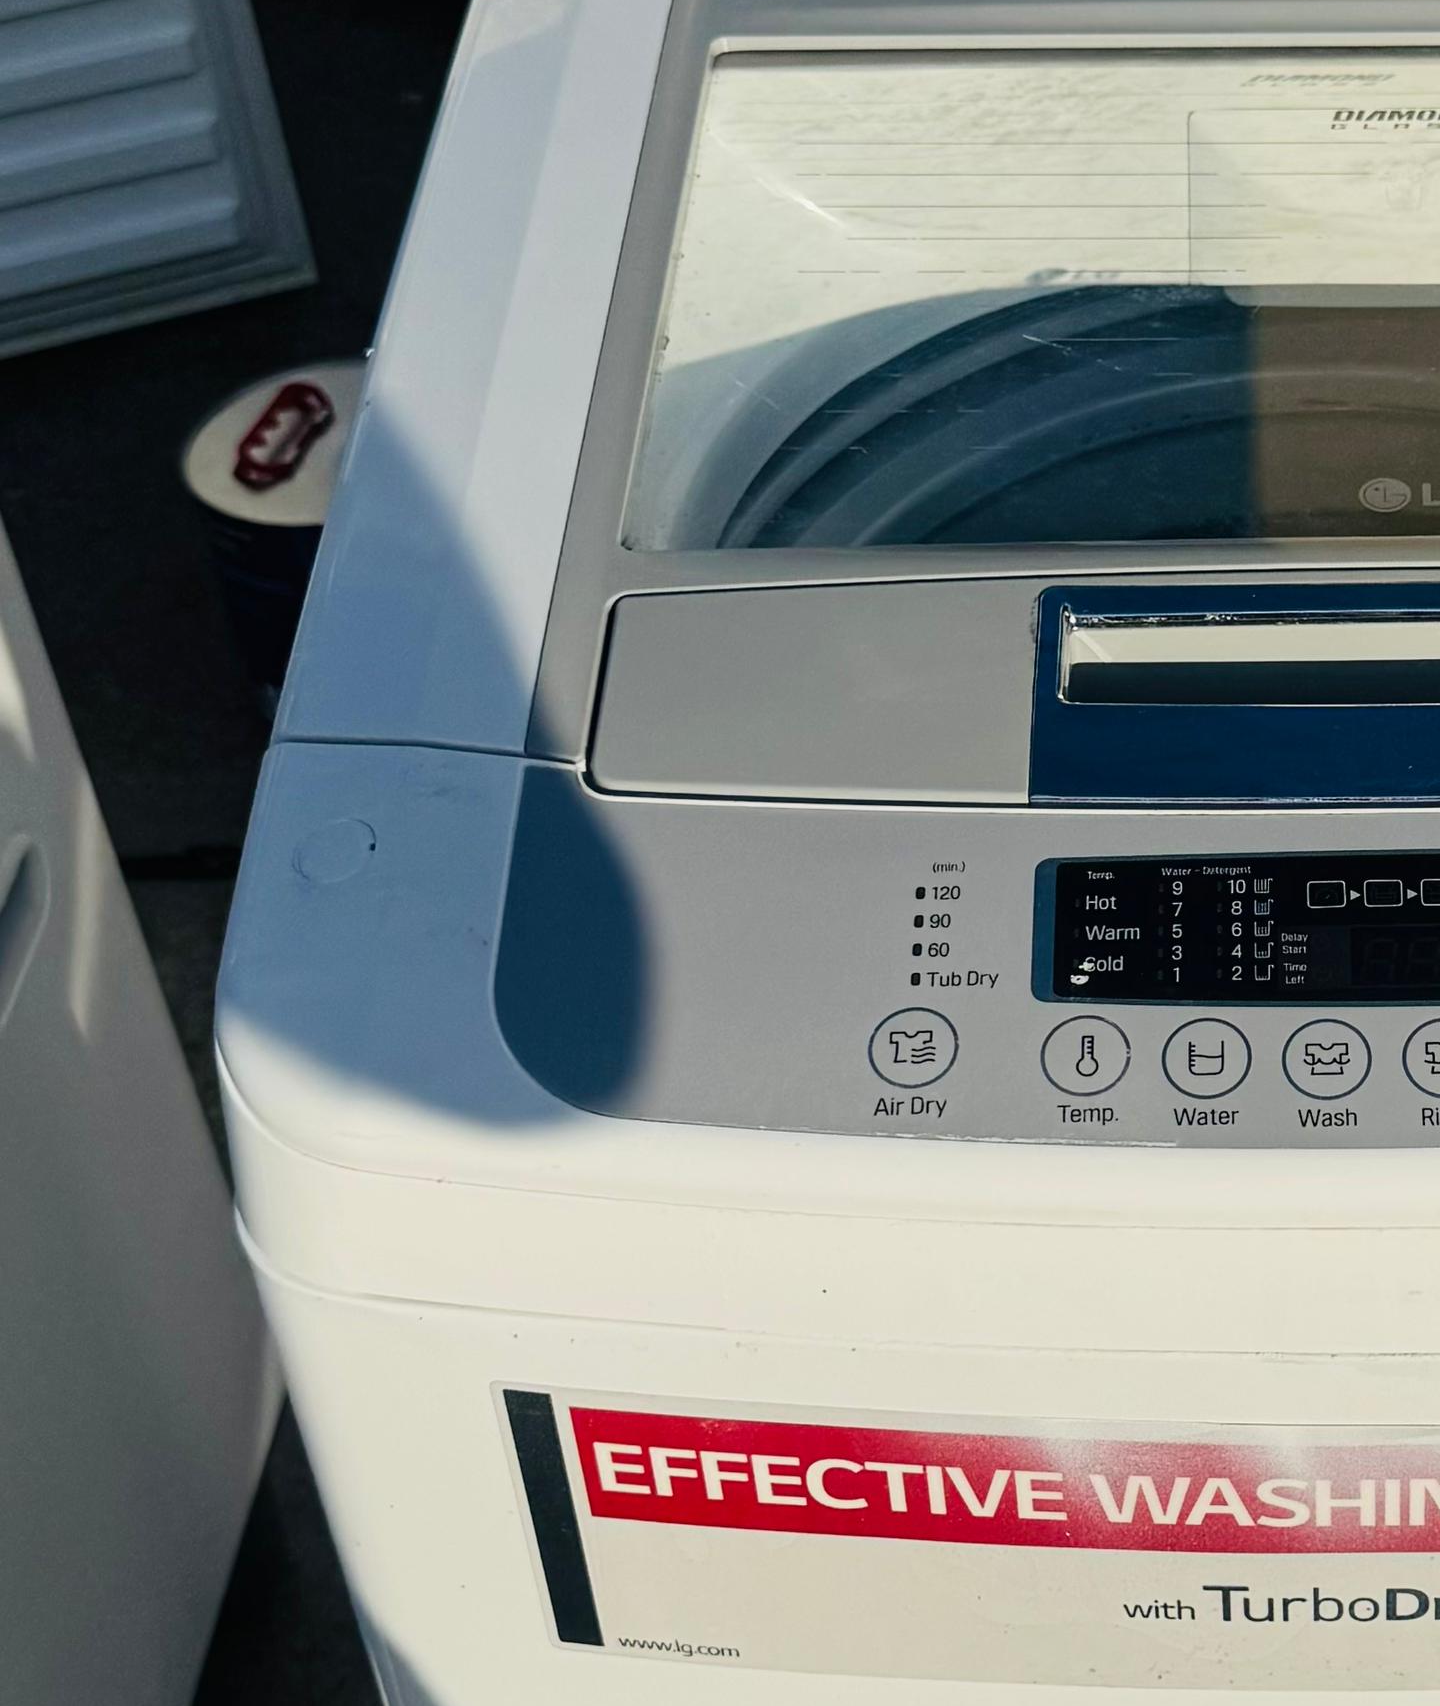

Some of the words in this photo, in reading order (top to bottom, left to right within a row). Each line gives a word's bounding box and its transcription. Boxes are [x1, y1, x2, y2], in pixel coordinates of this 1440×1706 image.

[931, 885, 962, 901] 120
[1172, 881, 1184, 896] 9
[1227, 879, 1246, 894] 10
[1084, 895, 1117, 911] Hot
[1171, 902, 1183, 917] 7
[1231, 900, 1243, 916] 8
[929, 913, 952, 929] 90
[1084, 925, 1141, 941] Warm
[1171, 924, 1183, 939] 5
[1231, 922, 1242, 937] 6
[927, 942, 950, 958] 60
[1171, 945, 1183, 961] 3
[1231, 943, 1243, 959] 4
[1084, 955, 1124, 972] Cold
[926, 971, 962, 988] Tub
[967, 970, 1000, 989] Dry
[1172, 966, 1181, 983] 1
[1231, 965, 1243, 981] 2
[873, 1097, 905, 1117] Air
[910, 1096, 948, 1119] Dry
[1057, 1104, 1120, 1126] Temp.
[1173, 1107, 1240, 1127] Water
[1297, 1108, 1359, 1128] Wash
[592, 1440, 1069, 1522] EFFECTIVE
[1122, 1598, 1197, 1622] with
[618, 1637, 741, 1658] www.lg.com
